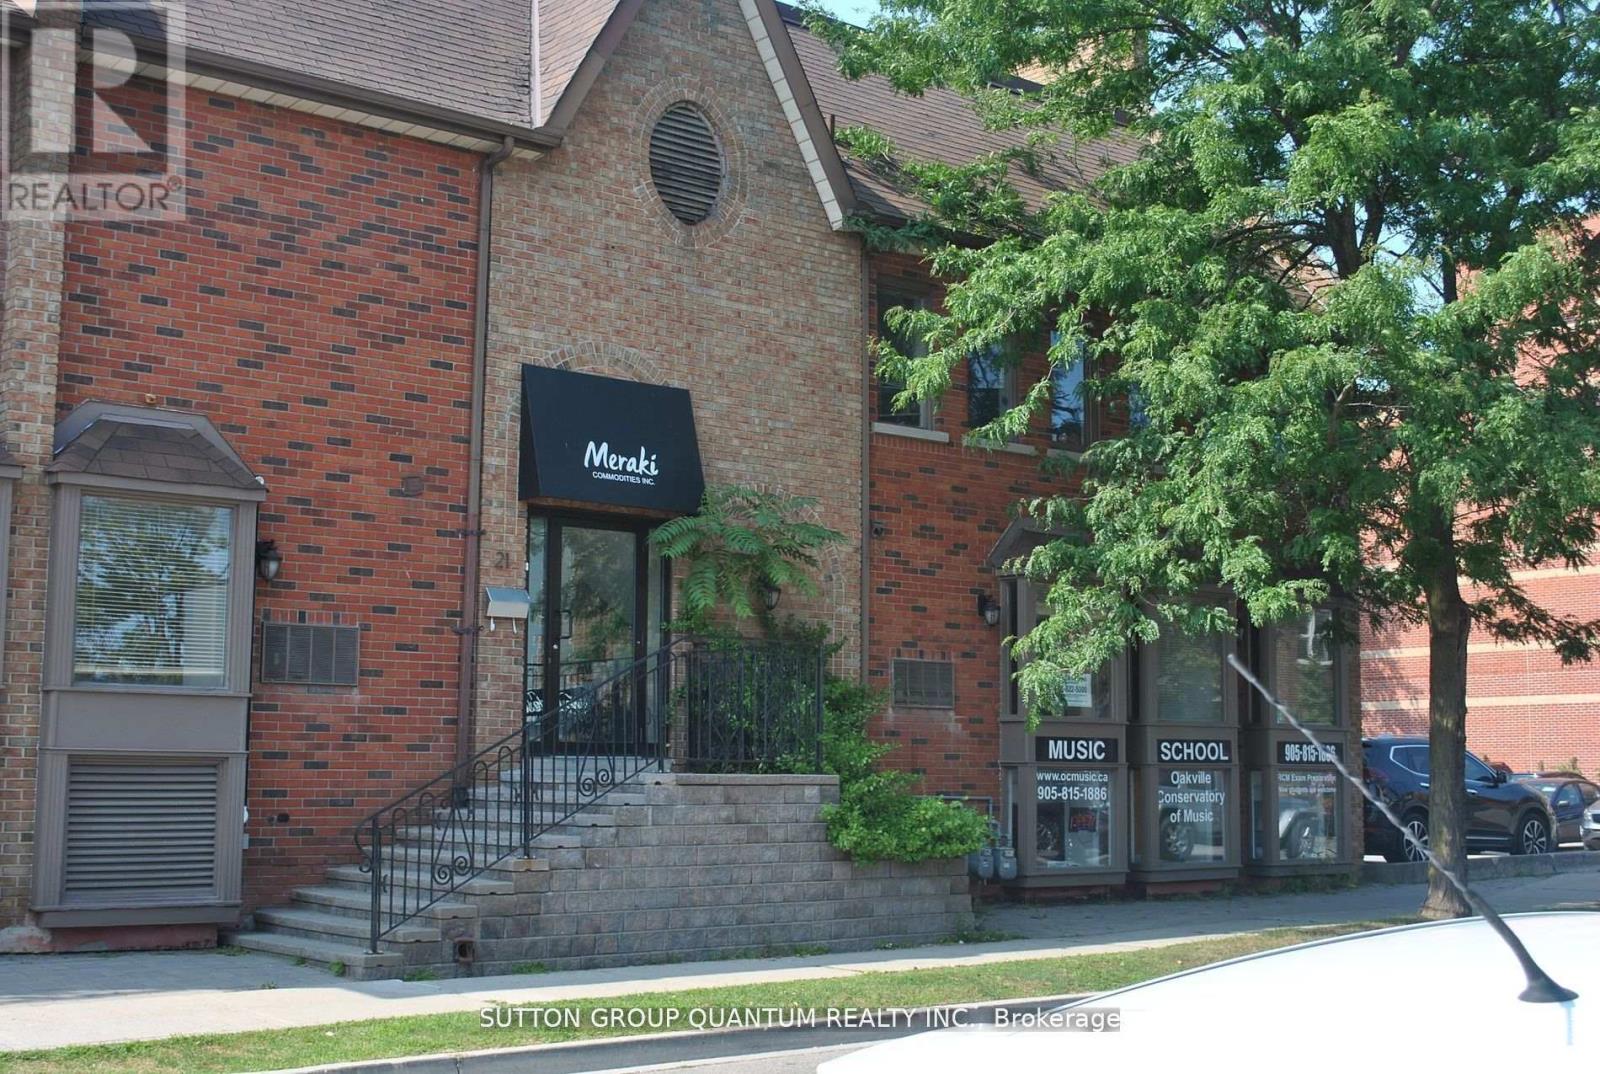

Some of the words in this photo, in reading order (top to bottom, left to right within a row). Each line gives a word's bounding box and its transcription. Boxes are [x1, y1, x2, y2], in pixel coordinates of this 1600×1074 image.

[584, 441, 659, 476] Meraki
[592, 471, 641, 483] COMMODITIES
[642, 477, 655, 486] INC.
[495, 551, 509, 569] 21
[1048, 740, 1106, 760] MUSIC
[1160, 742, 1229, 760] SCHOOL
[1036, 770, 1108, 782] www.ocmusic.ca
[1171, 771, 1212, 785] Oakville
[1037, 786, 1107, 800] 905-815-1886
[1170, 809, 1181, 823] of
[1183, 808, 1214, 823] Music
